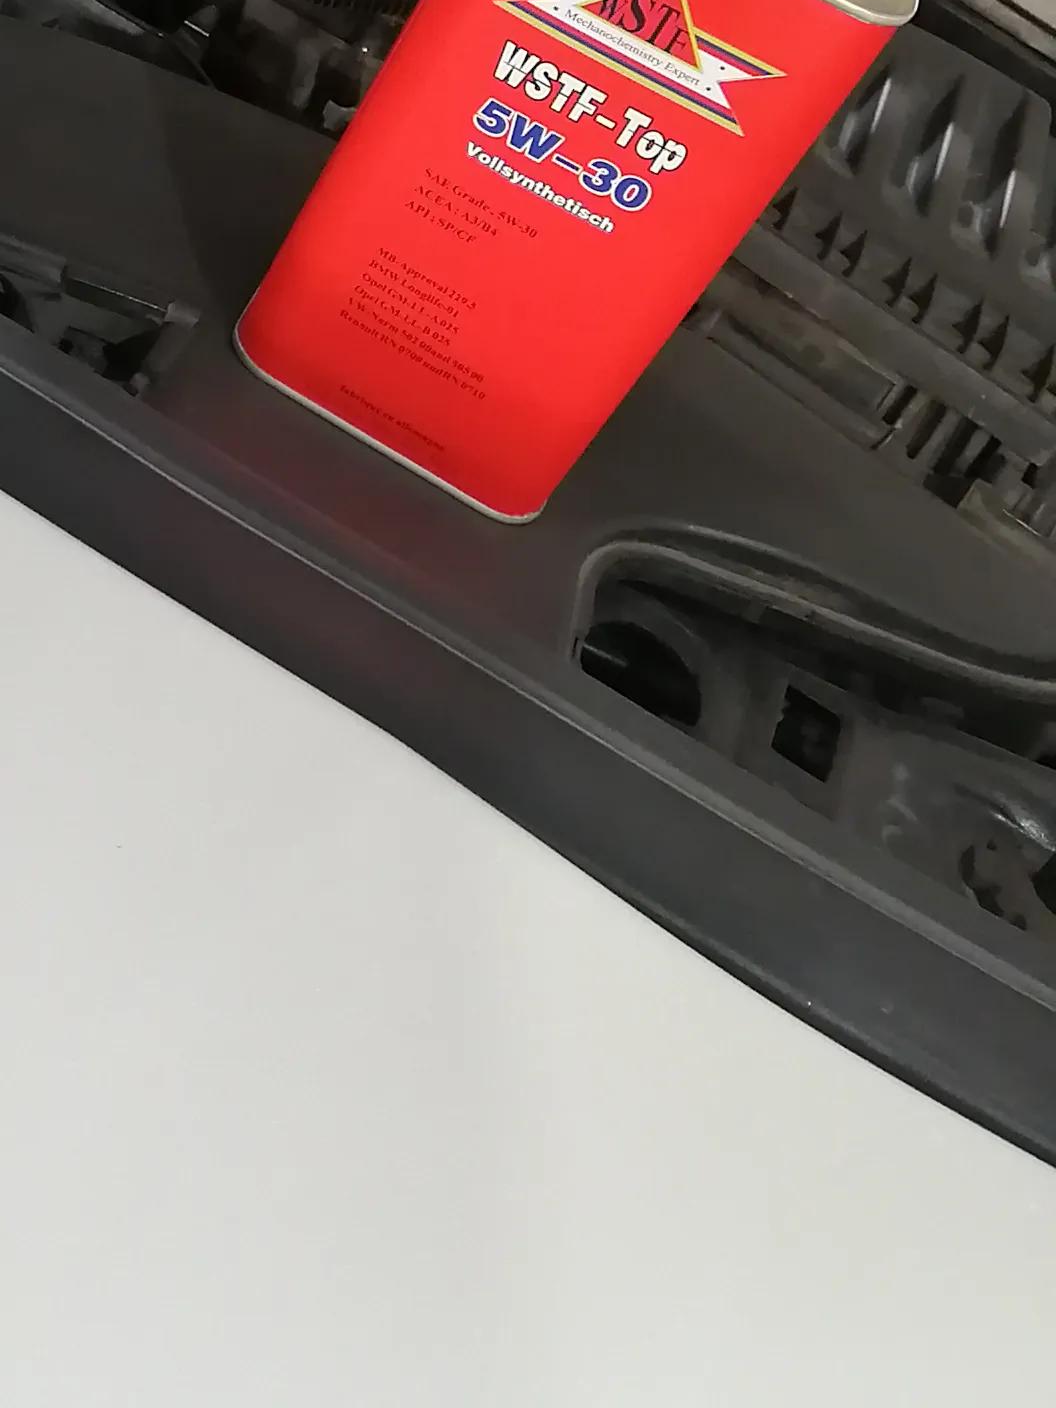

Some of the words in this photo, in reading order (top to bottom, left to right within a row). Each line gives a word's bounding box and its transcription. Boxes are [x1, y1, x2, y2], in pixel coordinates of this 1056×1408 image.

[565, 8, 663, 72] Mechanochemistry
[664, 60, 701, 87] Expert
[493, 40, 688, 174] WSTF-Top
[425, 168, 449, 190] SAE
[466, 142, 615, 233] Vollsynthetisch
[473, 97, 652, 211] 5W-30
[368, 259, 399, 281] BMW
